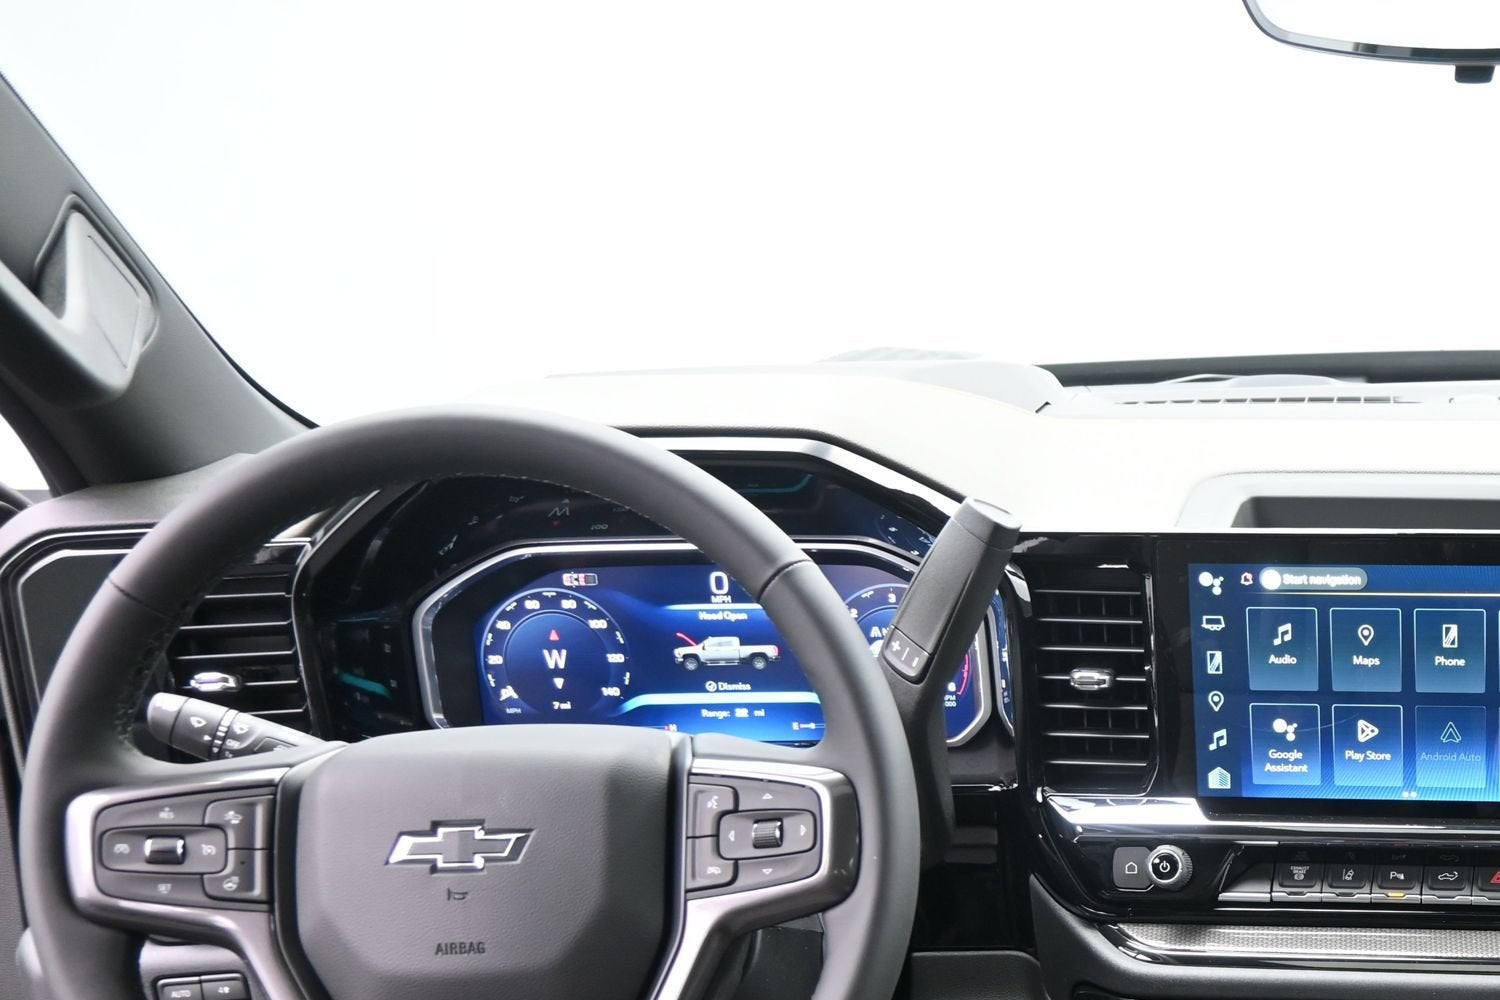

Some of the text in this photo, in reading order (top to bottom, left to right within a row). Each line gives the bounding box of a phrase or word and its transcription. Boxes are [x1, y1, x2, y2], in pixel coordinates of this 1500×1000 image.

[709, 571, 729, 594] 0
[1282, 574, 1361, 587] Start navigation
[888, 593, 896, 603] 3
[699, 611, 748, 621] Hood Open
[543, 649, 567, 669] W
[1268, 654, 1297, 664] Audio
[1353, 655, 1380, 666] Maps
[1435, 656, 1465, 666] Phone
[718, 682, 751, 691] Dismiss
[701, 709, 730, 719] Range:
[754, 709, 765, 717] mi
[1268, 750, 1303, 761] Google
[1345, 751, 1392, 763] Play Store
[1420, 752, 1481, 762] Android Auto
[1264, 763, 1308, 773] Assistant
[435, 942, 486, 955] AIRBAG
[171, 990, 191, 998] AUTO
